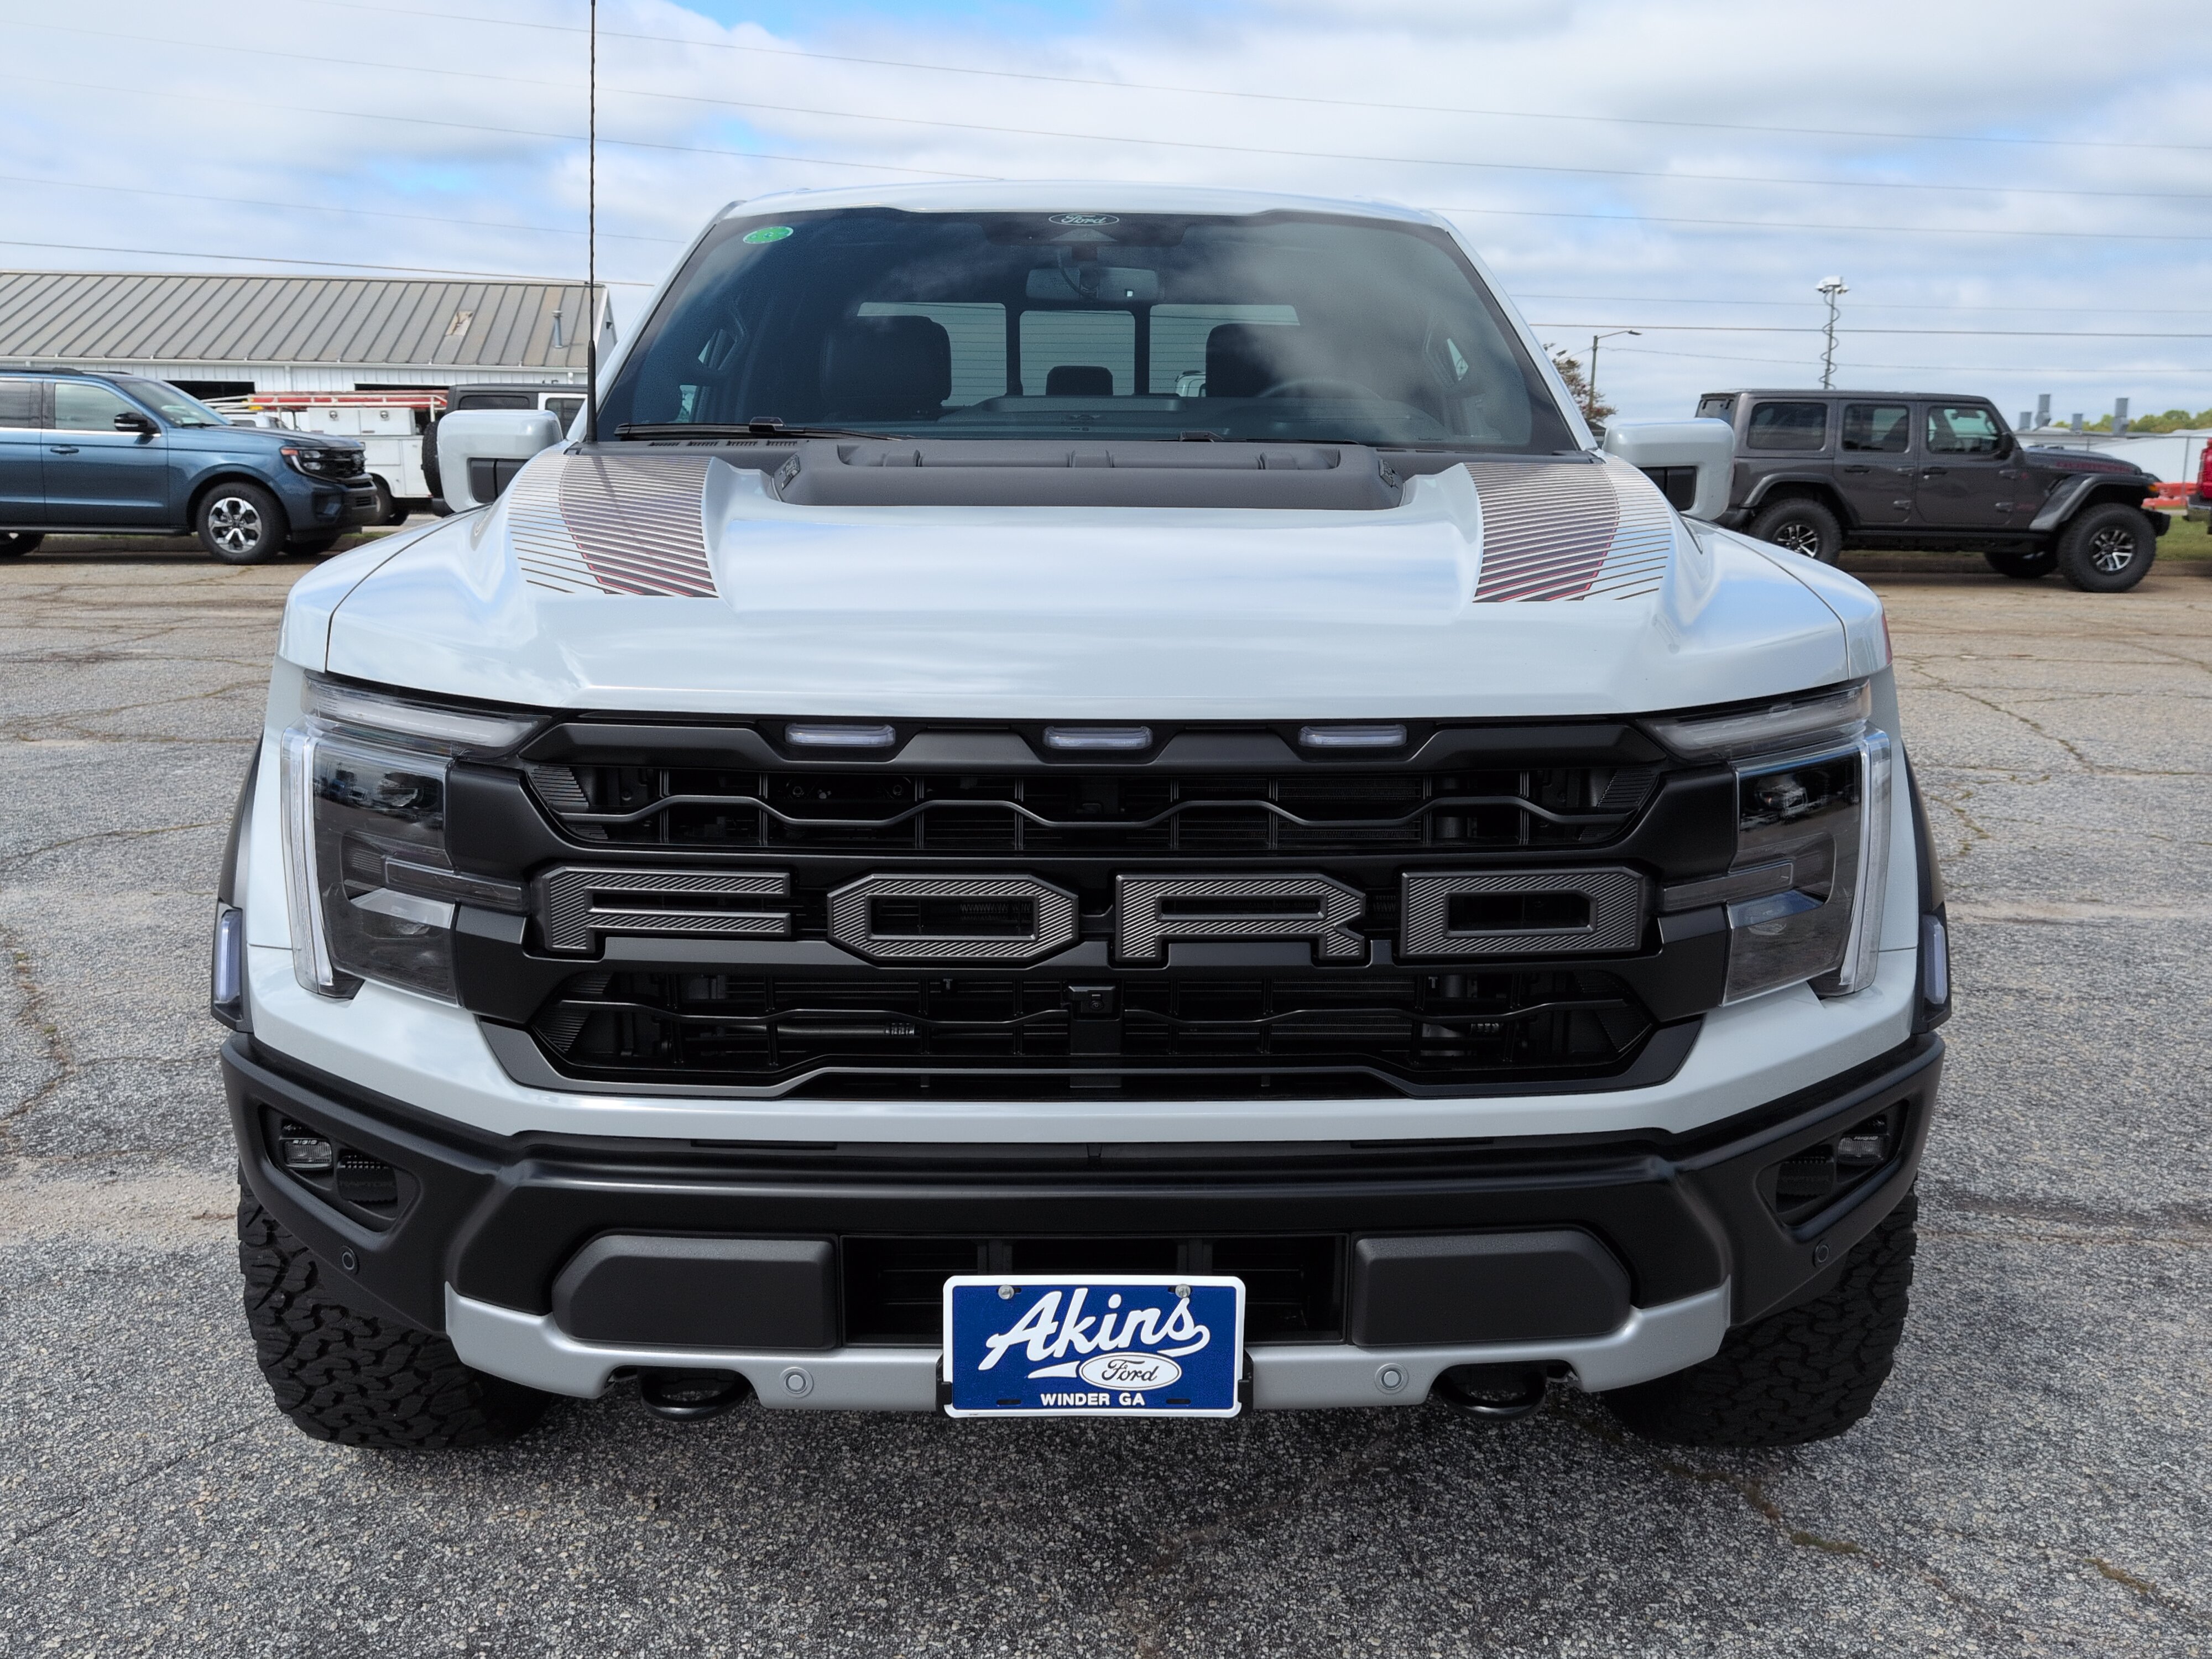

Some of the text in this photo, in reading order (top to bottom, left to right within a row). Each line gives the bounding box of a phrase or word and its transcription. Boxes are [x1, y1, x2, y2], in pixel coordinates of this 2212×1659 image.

[1061, 214, 1107, 223] Ford
[538, 867, 1644, 962] FORD
[978, 1287, 1211, 1370] Akins
[1101, 1359, 1159, 1381] Ford
[1040, 1392, 1145, 1406] WINDER GA
